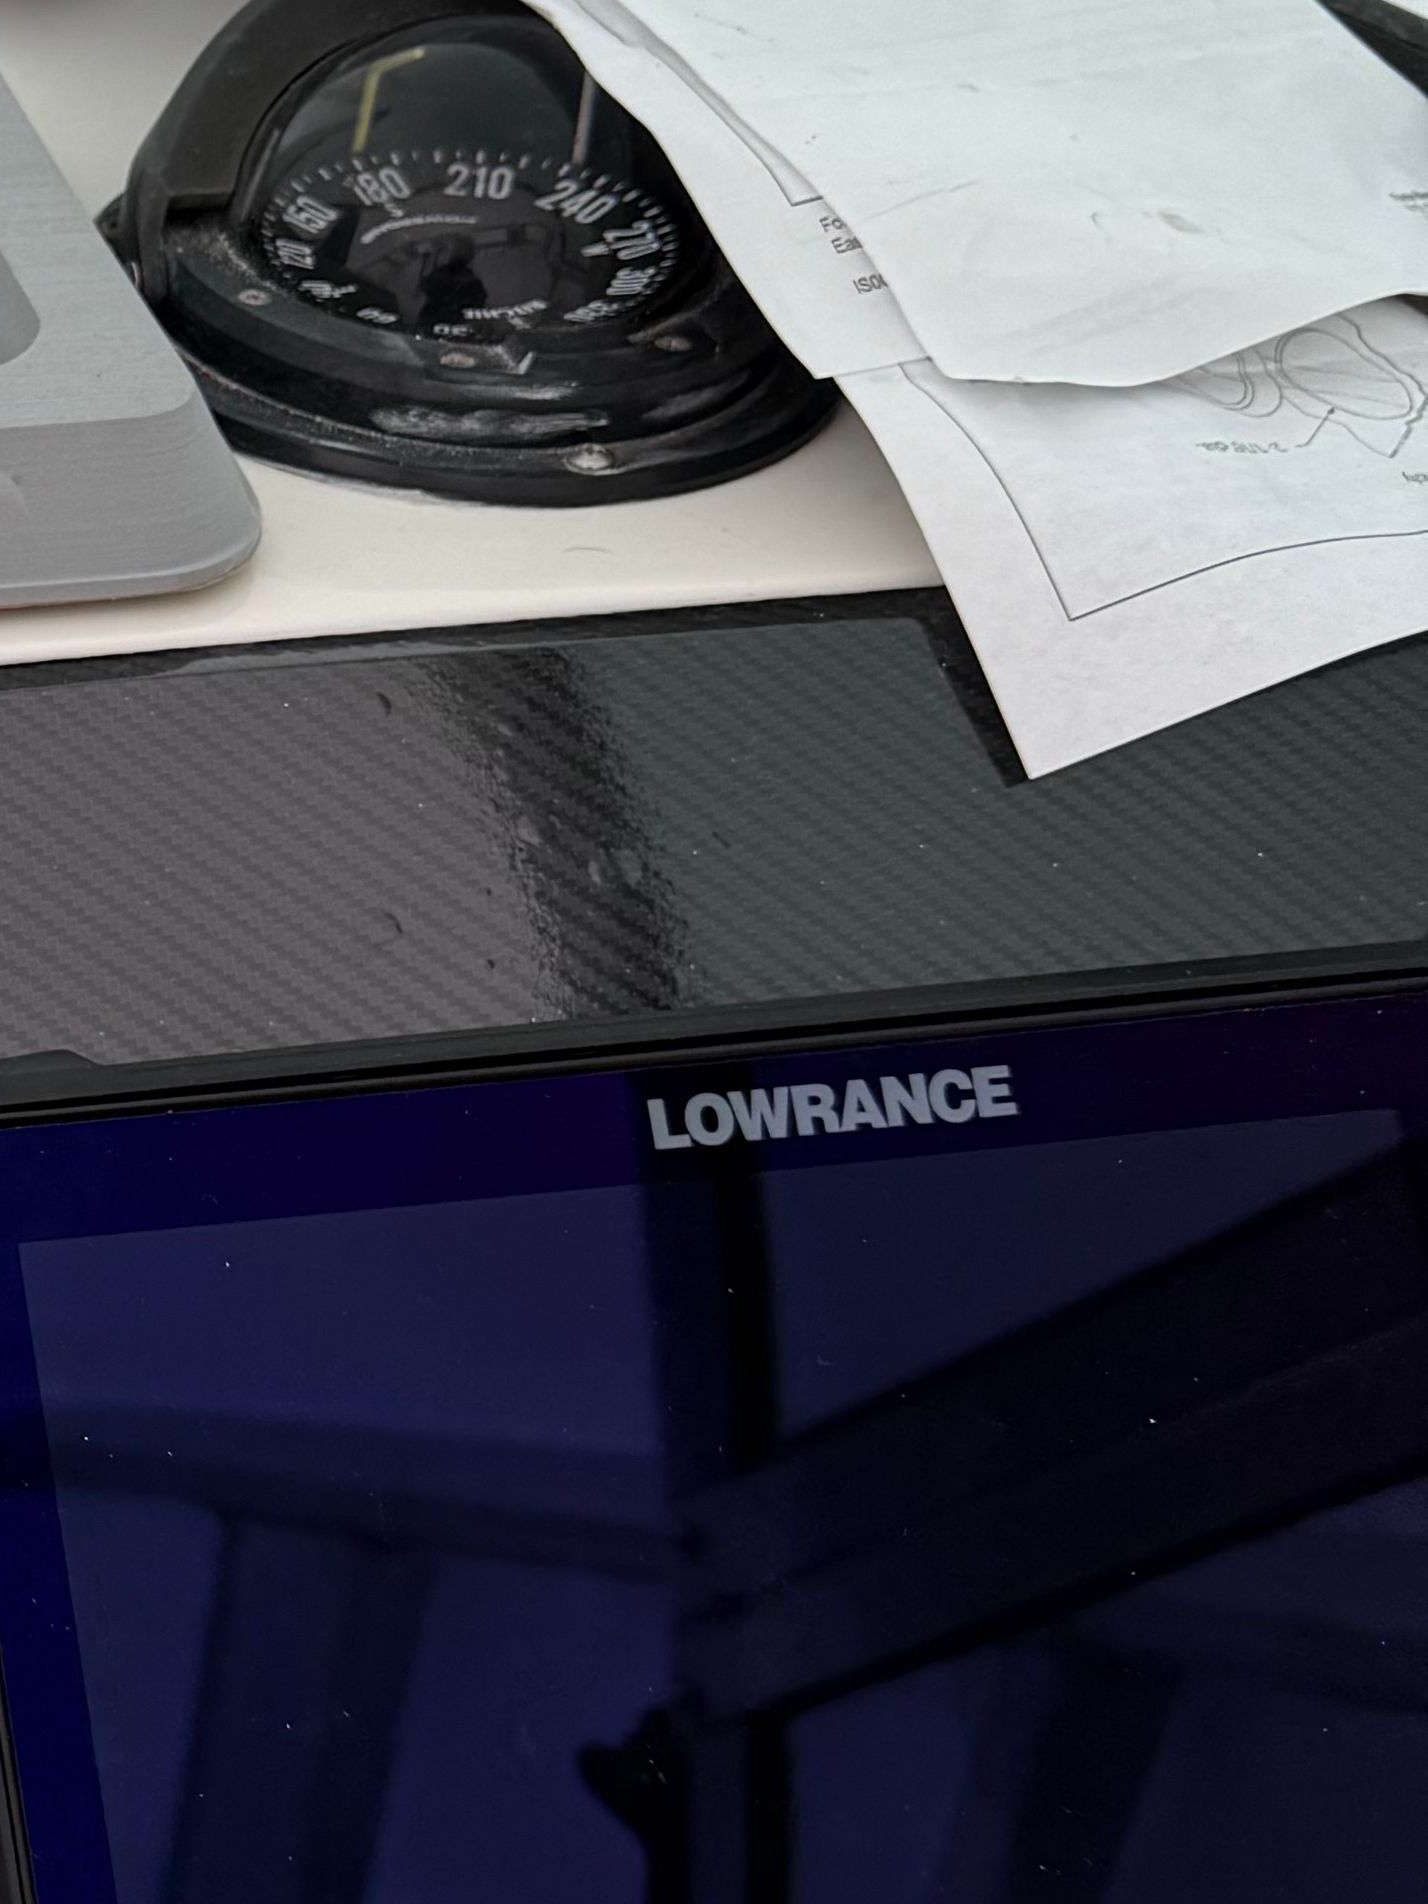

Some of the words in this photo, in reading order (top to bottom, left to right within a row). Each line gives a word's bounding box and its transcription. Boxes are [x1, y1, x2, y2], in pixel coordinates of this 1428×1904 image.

[354, 167, 410, 207] 180
[444, 164, 512, 199] 210
[534, 178, 618, 224] 240
[282, 196, 338, 234] 150
[603, 220, 660, 260] 270
[647, 1064, 1020, 1151] LOWRANCE
